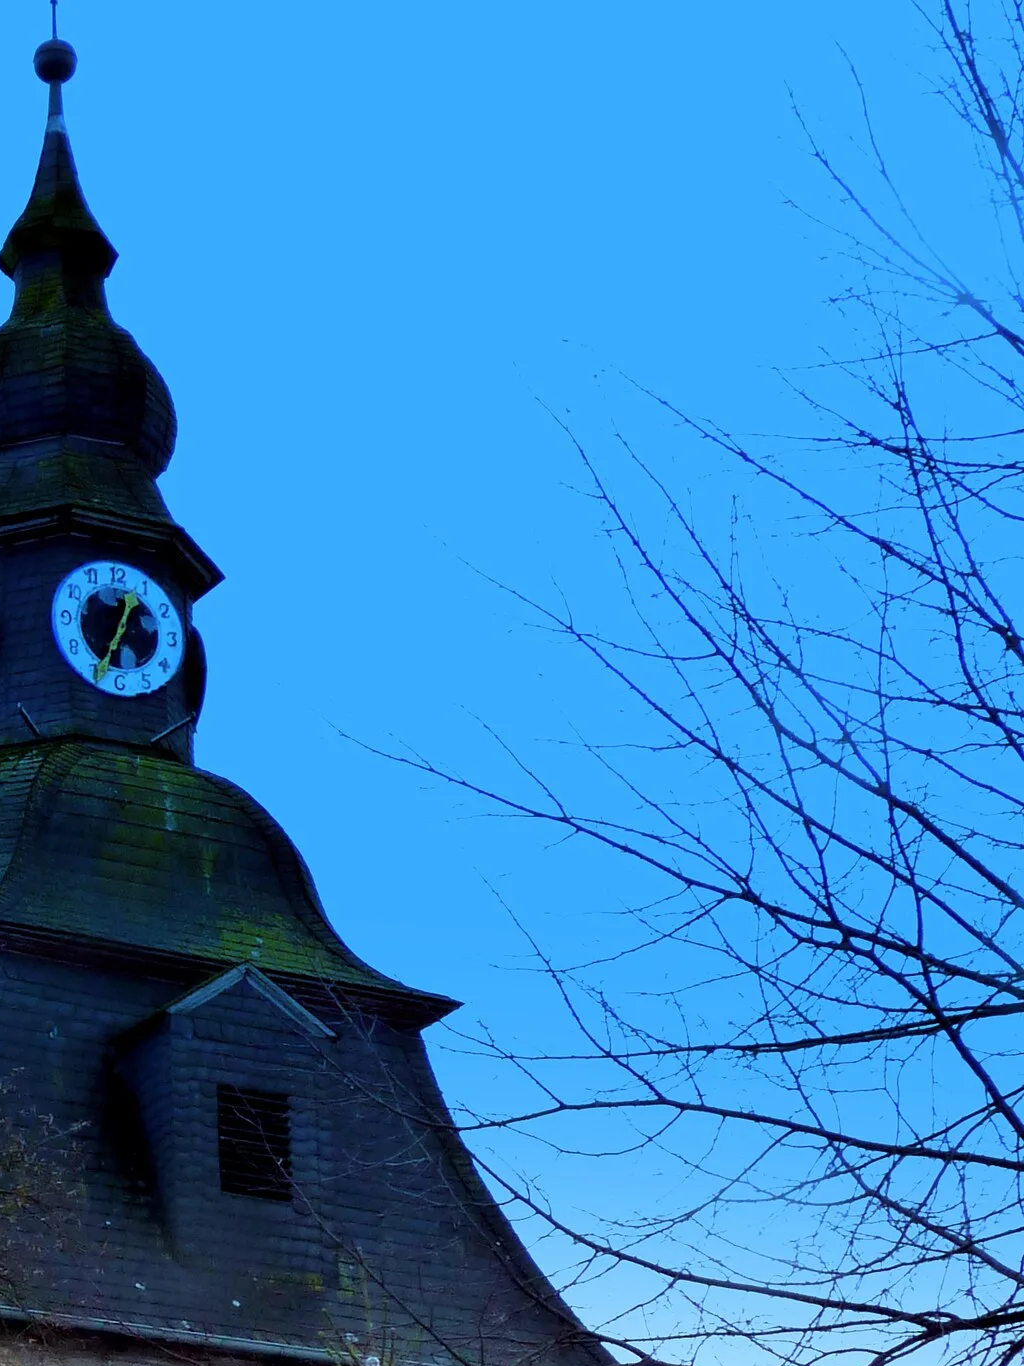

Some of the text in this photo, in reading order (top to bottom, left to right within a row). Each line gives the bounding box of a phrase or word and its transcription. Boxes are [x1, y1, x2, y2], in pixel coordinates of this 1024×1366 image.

[83, 567, 98, 585] 11
[109, 566, 126, 585] 12
[67, 583, 82, 601] 10
[141, 580, 149, 596] 1
[60, 609, 72, 626] 9
[158, 603, 170, 619] 2
[68, 638, 79, 656] 8
[166, 631, 177, 648] 3
[157, 657, 171, 673] 4
[114, 674, 126, 691] 6
[141, 673, 152, 690] 5
